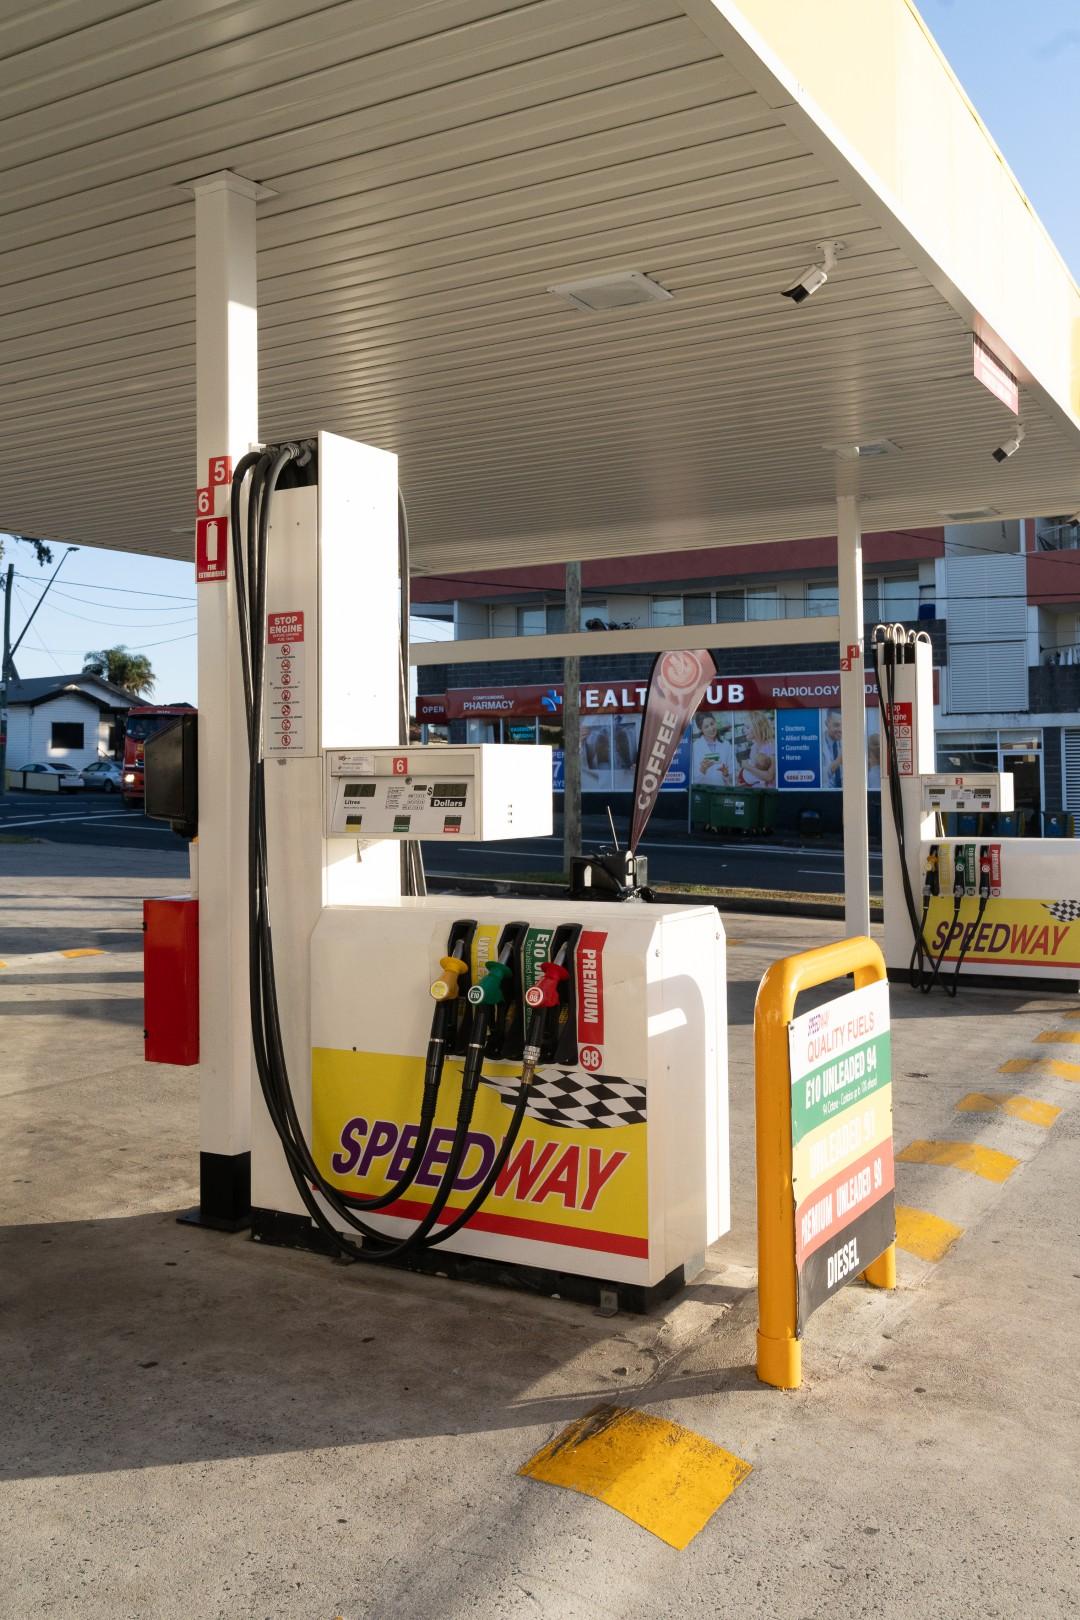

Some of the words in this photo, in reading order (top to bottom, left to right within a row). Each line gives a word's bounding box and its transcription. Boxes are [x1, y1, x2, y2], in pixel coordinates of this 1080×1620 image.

[214, 461, 225, 481] 5
[198, 492, 209, 512] 6
[270, 624, 302, 634] ENGINE
[274, 616, 298, 625] STOP
[851, 648, 857, 656] 1
[841, 660, 849, 670] 2
[578, 688, 647, 708] EALT
[706, 684, 745, 704] UB
[772, 686, 840, 697] RADIOLOGY
[422, 706, 444, 714] OPEN
[464, 700, 514, 710] PHARMACY
[396, 760, 404, 773] 6
[552, 760, 562, 778] 7
[637, 709, 679, 811] COFFEE
[427, 786, 433, 796] $
[534, 933, 550, 958] E10
[932, 920, 1070, 956] SPEEDWAY
[582, 949, 598, 1024] PREMIUM
[807, 1024, 846, 1064] QUALITY
[847, 1012, 875, 1039] FUELS
[582, 1050, 599, 1068] 98
[805, 1077, 820, 1110] E10
[823, 1050, 865, 1098] UNLEADED
[867, 1045, 877, 1072] 94
[331, 1117, 630, 1212] SPEEDWAY
[801, 1193, 832, 1248] PREMIUM
[836, 1166, 871, 1218] UNLEADED
[827, 1237, 860, 1289] DIESEL
